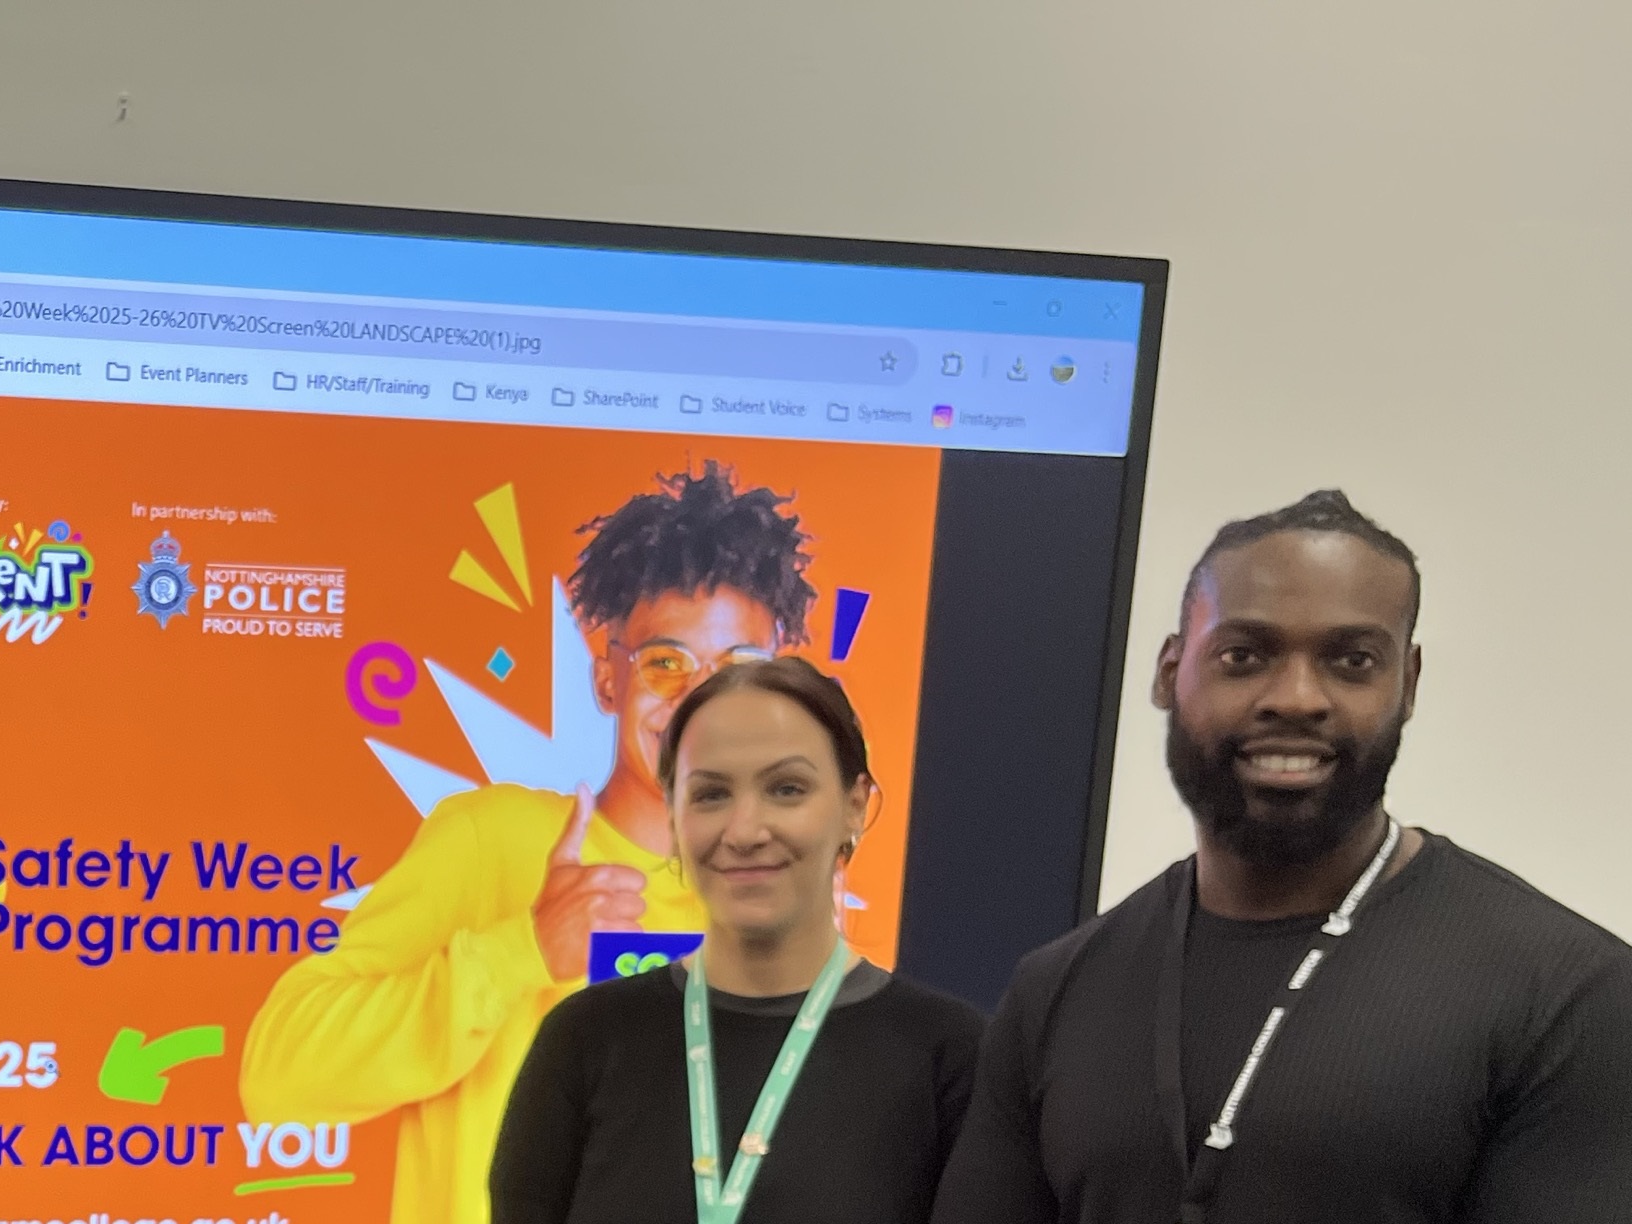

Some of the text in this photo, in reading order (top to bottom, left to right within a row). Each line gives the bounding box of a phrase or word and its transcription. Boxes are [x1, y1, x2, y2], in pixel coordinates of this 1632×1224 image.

[141, 365, 248, 386] Event Planners
[306, 374, 431, 399] HR/Staff/Training
[486, 384, 530, 405] Kenya
[583, 389, 659, 409] SharePoint
[711, 396, 766, 415] Student
[131, 502, 277, 525] In partnership with:
[204, 569, 345, 588] NOTTINGHAMSHIRE
[203, 584, 346, 614] POLICE
[202, 618, 343, 639] PROUD TO SERVE
[191, 840, 359, 892] Week
[41, 1124, 224, 1167] ABOUT
[236, 1122, 350, 1168] YOU
